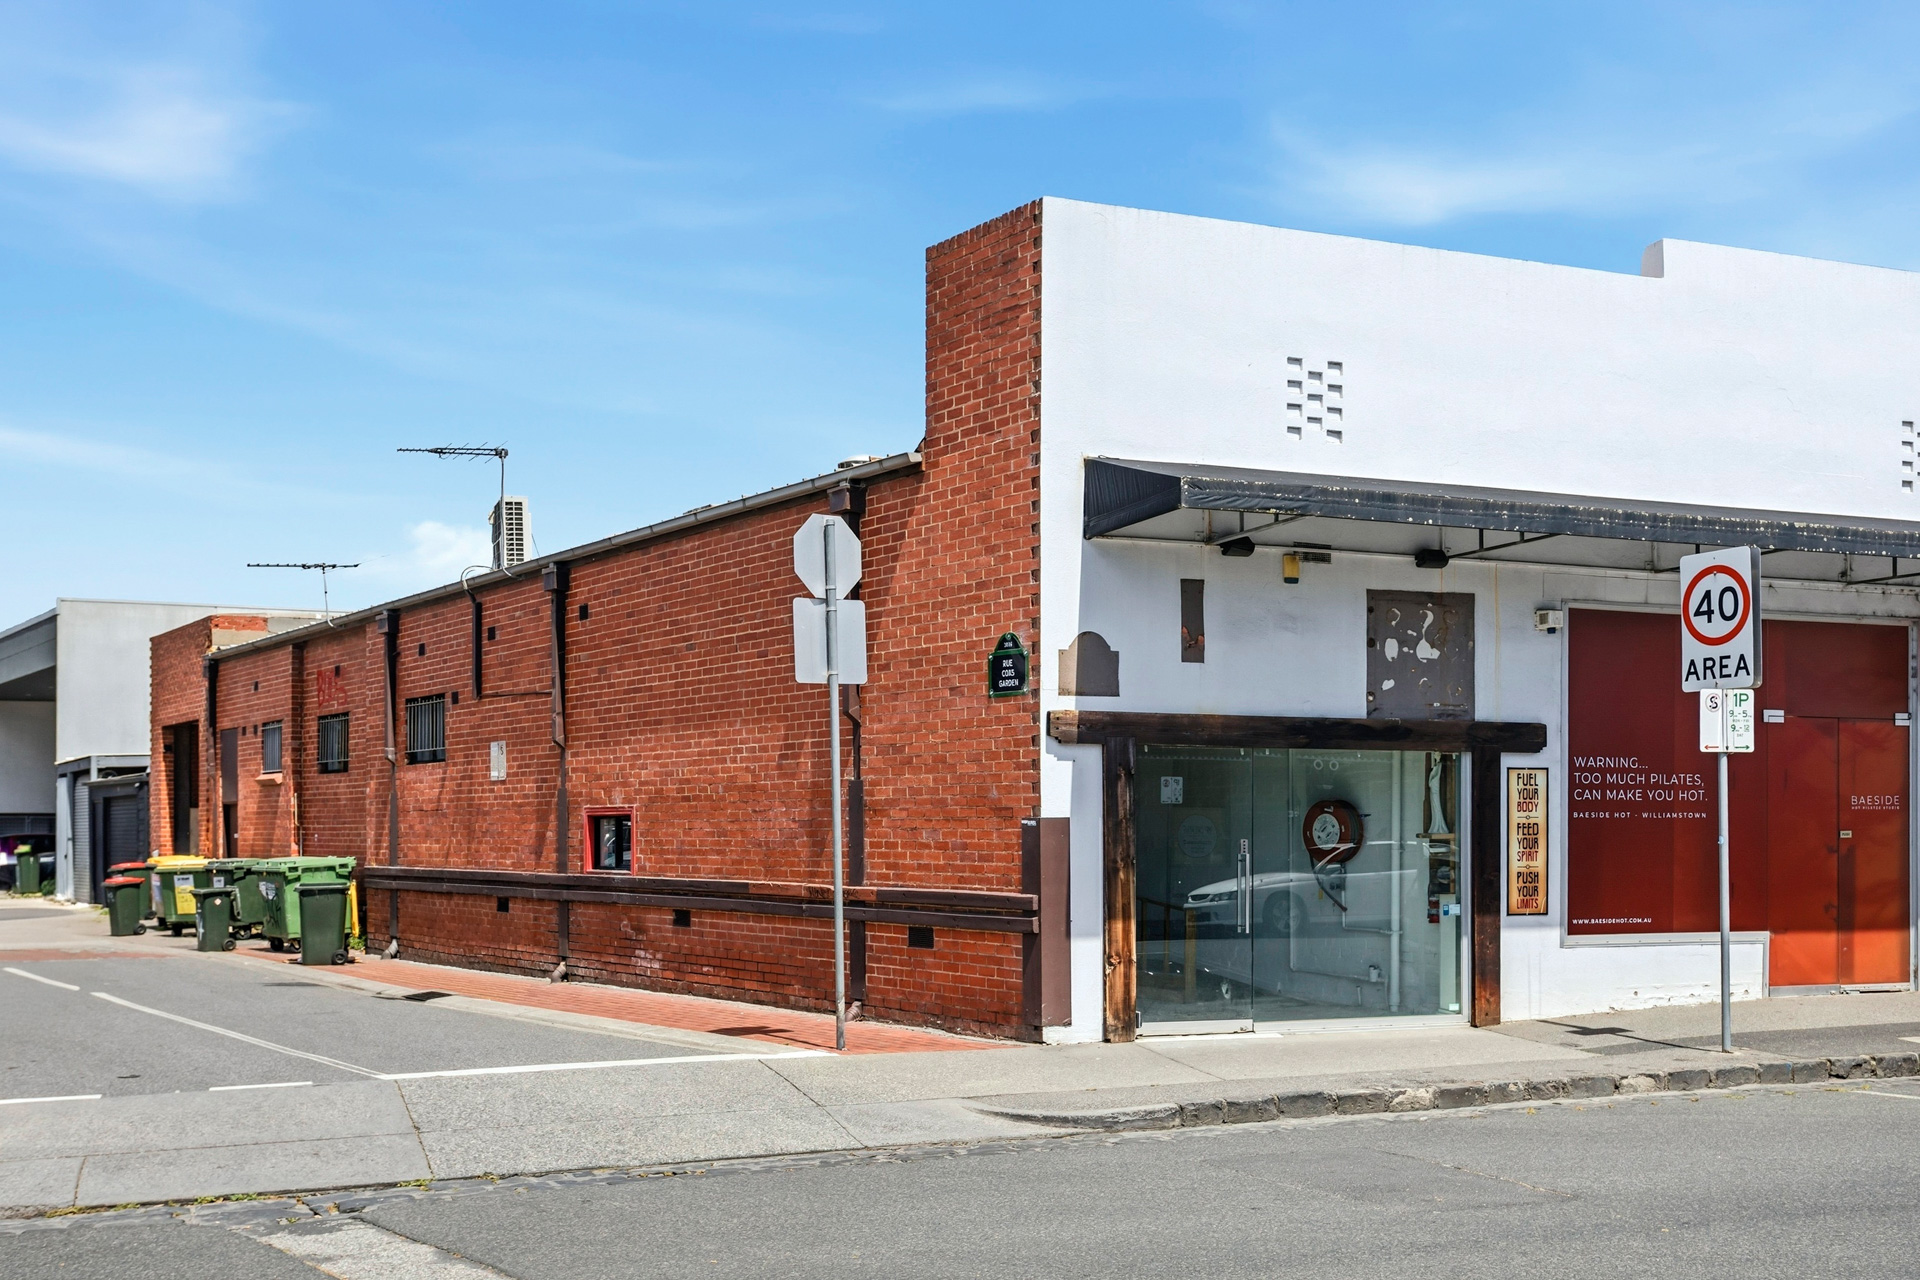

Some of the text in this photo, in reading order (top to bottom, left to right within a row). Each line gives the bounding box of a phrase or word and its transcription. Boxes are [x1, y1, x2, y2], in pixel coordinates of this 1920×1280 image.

[1693, 586, 1739, 624] 40
[1002, 659, 1013, 668] RUE
[1684, 653, 1750, 682] AREA
[998, 679, 1018, 688] GARDEN
[1733, 692, 1750, 708] 1P
[1574, 756, 1648, 768] WARNING...
[1516, 773, 1538, 786] FUEL
[1574, 772, 1704, 787] TOO MUCH PILATES,
[1516, 788, 1539, 800] YOUR
[1574, 789, 1708, 801] CAN MAKE YOU HOT.
[1851, 795, 1900, 805] BAESIDE
[1516, 801, 1539, 812] BODY
[1516, 823, 1539, 836] FEED
[1516, 837, 1539, 850] YOUR
[1516, 851, 1538, 862] SPIRIT
[1516, 872, 1539, 884] PUSH
[1516, 886, 1539, 897] YOUR
[1516, 898, 1538, 909] LIMITS
